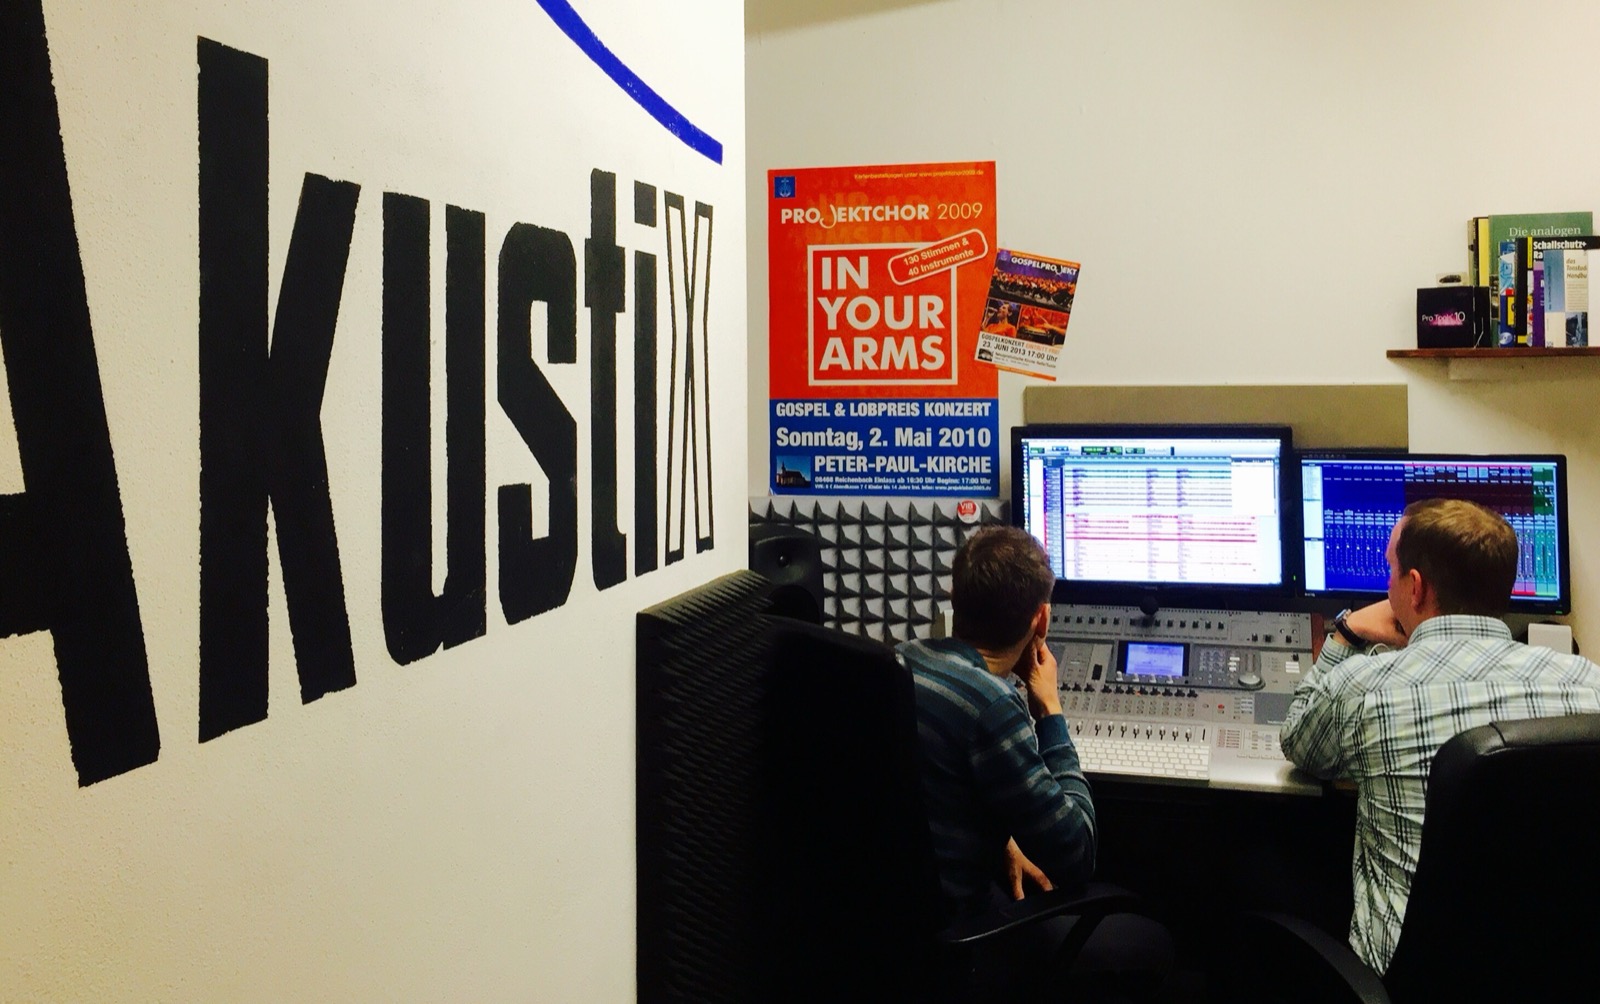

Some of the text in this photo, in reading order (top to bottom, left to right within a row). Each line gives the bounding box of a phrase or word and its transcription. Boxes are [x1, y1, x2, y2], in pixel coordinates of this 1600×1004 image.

[781, 202, 983, 229] PROJEKTCHOR 2009
[1509, 226, 1581, 237] Die analogen
[903, 237, 970, 266] 130 Stimmen &
[822, 256, 869, 290] IN
[908, 249, 974, 277] 40 Instrumente
[1011, 256, 1078, 276] GOSPELPROJEKT
[817, 295, 945, 331] YOUR
[1454, 311, 1466, 322] 10
[981, 333, 1025, 347] GOSPELKONZERT
[982, 340, 1058, 362] 23. JUNI 2013 17:00 Uhr
[819, 335, 945, 371] ARMS
[776, 402, 992, 417] GOSPEL & LOBPREIS KONZERT
[776, 427, 992, 450] Sonntag, 2. Mai 2010
[814, 455, 992, 474] PETER-PAUL-KIRCHE
[936, 477, 960, 485] Beginn:
